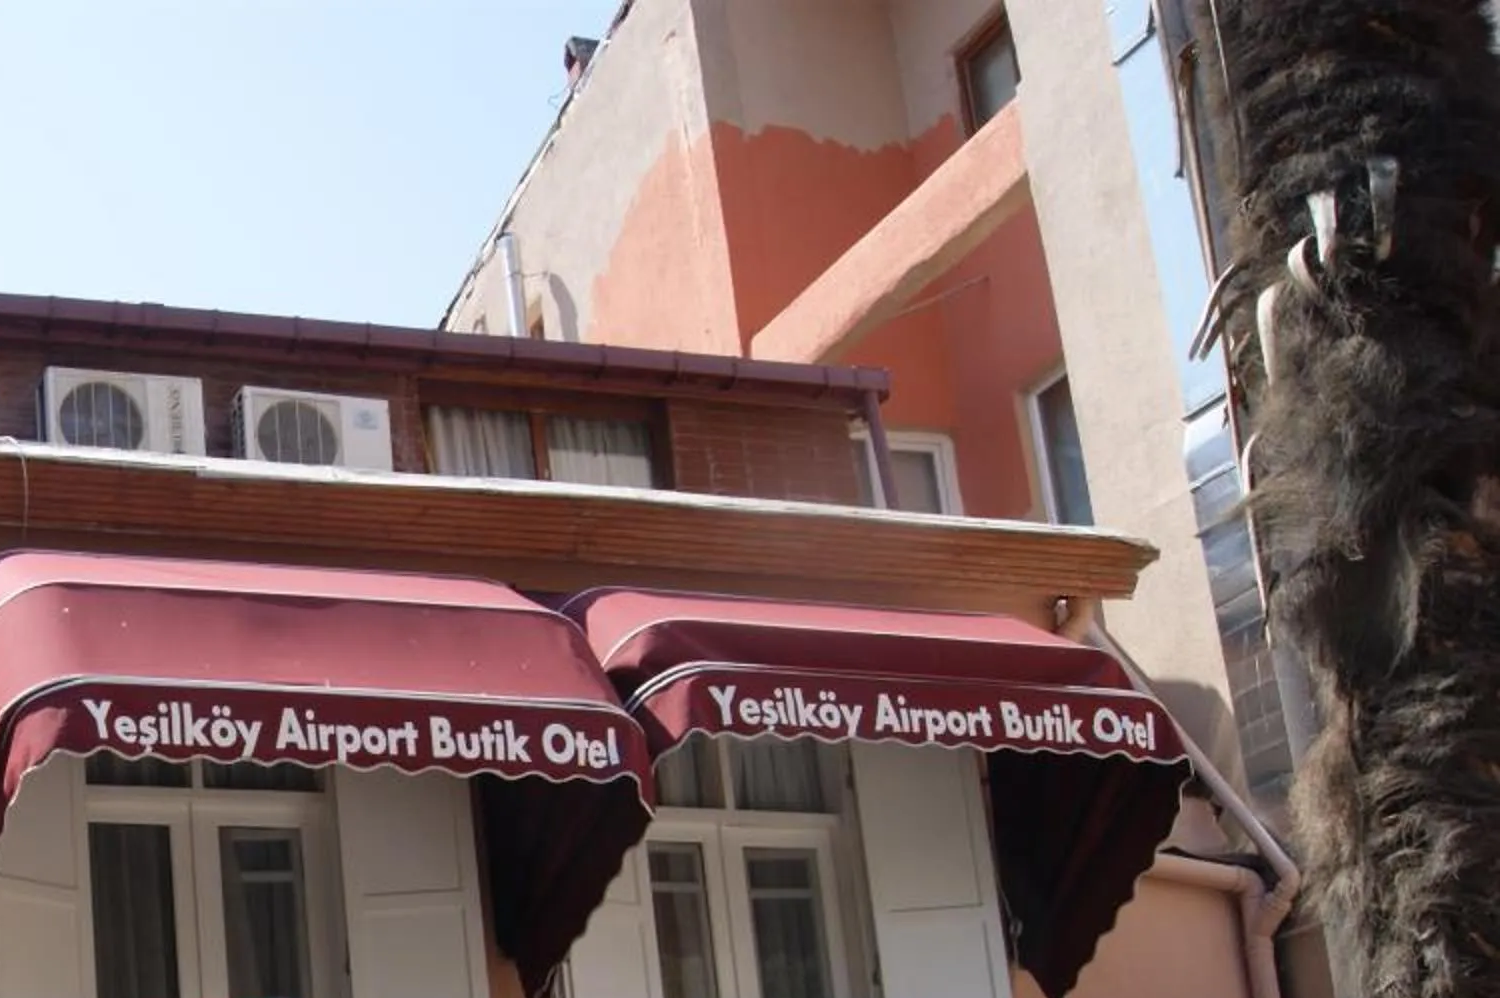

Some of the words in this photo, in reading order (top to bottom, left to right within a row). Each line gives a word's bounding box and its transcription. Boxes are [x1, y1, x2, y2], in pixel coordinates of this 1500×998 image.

[83, 700, 261, 758] Yeşilköy
[277, 708, 418, 761] Airport
[430, 716, 531, 762] Butik
[541, 723, 621, 768] Otel
[709, 686, 862, 736] Yeşilköy
[875, 695, 992, 740] Airport
[1001, 702, 1085, 744] Butik
[1092, 708, 1155, 750] Otel
